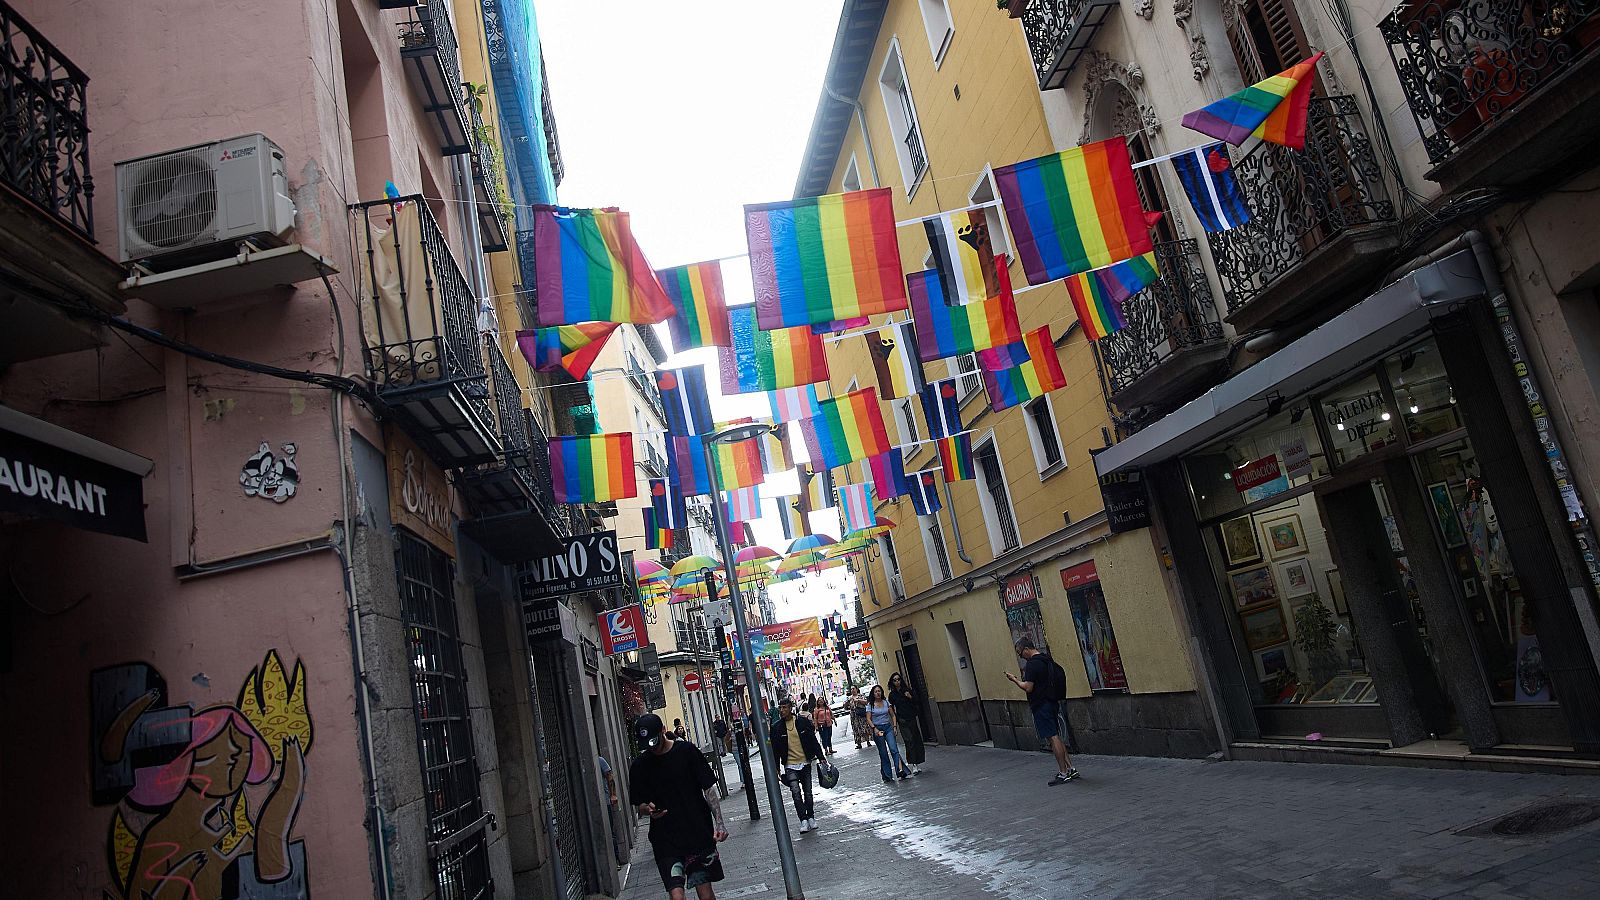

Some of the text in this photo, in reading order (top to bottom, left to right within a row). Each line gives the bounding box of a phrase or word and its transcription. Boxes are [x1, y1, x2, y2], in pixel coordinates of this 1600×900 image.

[1236, 461, 1278, 486] LIQUIDACIÓN
[1107, 498, 1145, 513] Taller de
[1113, 511, 1146, 524] Marcos
[525, 607, 559, 624] OUTLET
[527, 624, 561, 636] ADDICTED
